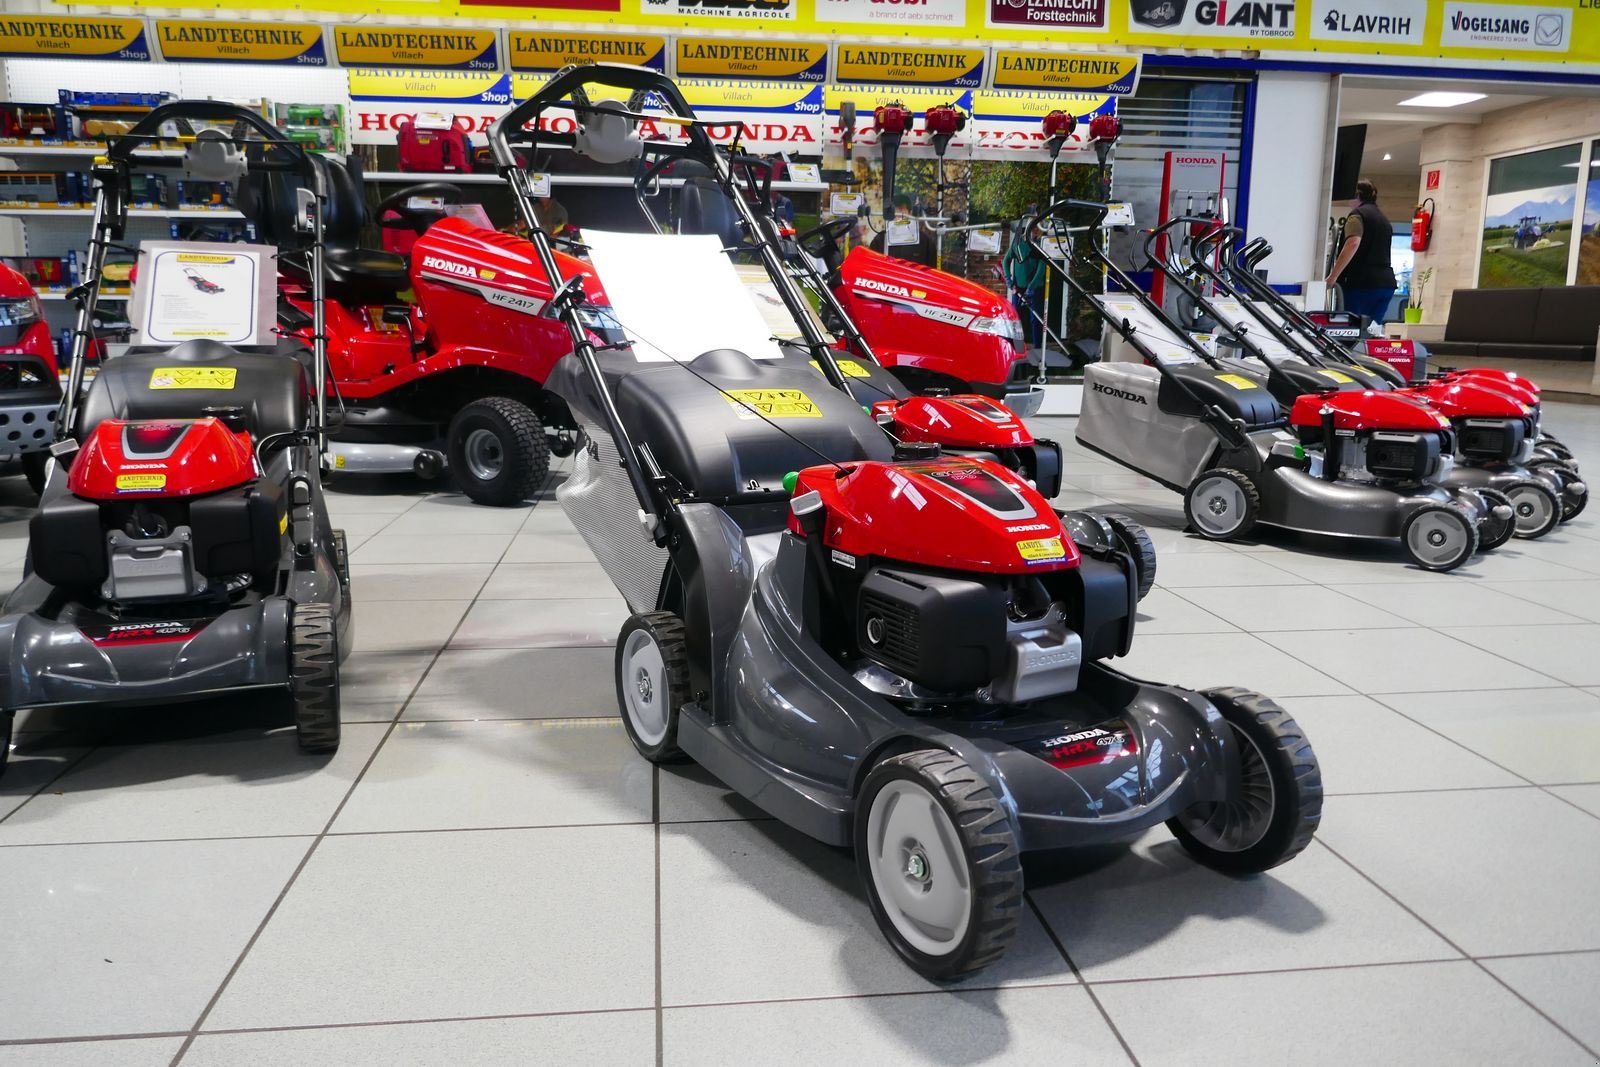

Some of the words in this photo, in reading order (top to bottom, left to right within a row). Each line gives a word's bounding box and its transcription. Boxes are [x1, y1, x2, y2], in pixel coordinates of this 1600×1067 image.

[678, 8, 732, 16] MACCHINE
[738, 10, 790, 18] AGRICOLE
[876, 10, 898, 18] brand
[925, 12, 953, 21] schmidt
[1027, 8, 1096, 22] Forsttechnik
[1195, 0, 1294, 28] GIANT
[1341, 14, 1411, 35] LAVRIH
[1452, 11, 1530, 34] VOGELSANG
[164, 26, 304, 45] LANDTECHNIK
[341, 32, 477, 50] LANDTECHNIK
[36, 40, 70, 49] Villach
[217, 45, 250, 54] Villach
[515, 37, 647, 56] LANDTECHNIK
[119, 50, 147, 60] Shop
[392, 51, 424, 60] Villach
[683, 44, 809, 62] LANDTECHNIK
[297, 55, 324, 65] Shop
[469, 60, 495, 69] Shop
[563, 57, 594, 65] Villach
[844, 50, 967, 69] LANDTECHNIK
[728, 63, 758, 71] Villach
[1002, 57, 1120, 75] LANDTECHNIK
[798, 71, 823, 81] Shop
[887, 69, 916, 77] Villach
[954, 77, 979, 86] Shop
[1042, 75, 1070, 83] Villach
[405, 82, 436, 92] Villach
[1106, 84, 1130, 92] Shop
[481, 91, 508, 104] Shop
[723, 91, 753, 101] Villach
[794, 101, 820, 113] Shop
[1022, 102, 1050, 112] Villach
[358, 113, 498, 134] HODA
[522, 116, 660, 139] HOA
[1176, 157, 1217, 165] HONDA
[422, 256, 478, 279] HONDA
[854, 277, 910, 298] HONDA
[492, 292, 506, 303] HF
[507, 297, 534, 309] 2417
[941, 312, 965, 323] 2317
[1092, 382, 1148, 405] HONDA
[1006, 523, 1051, 533] HONDA
[109, 622, 184, 632] HONDA
[106, 629, 158, 639] HRX
[1041, 728, 1110, 748] HONDA
[1052, 741, 1097, 759] HRX
